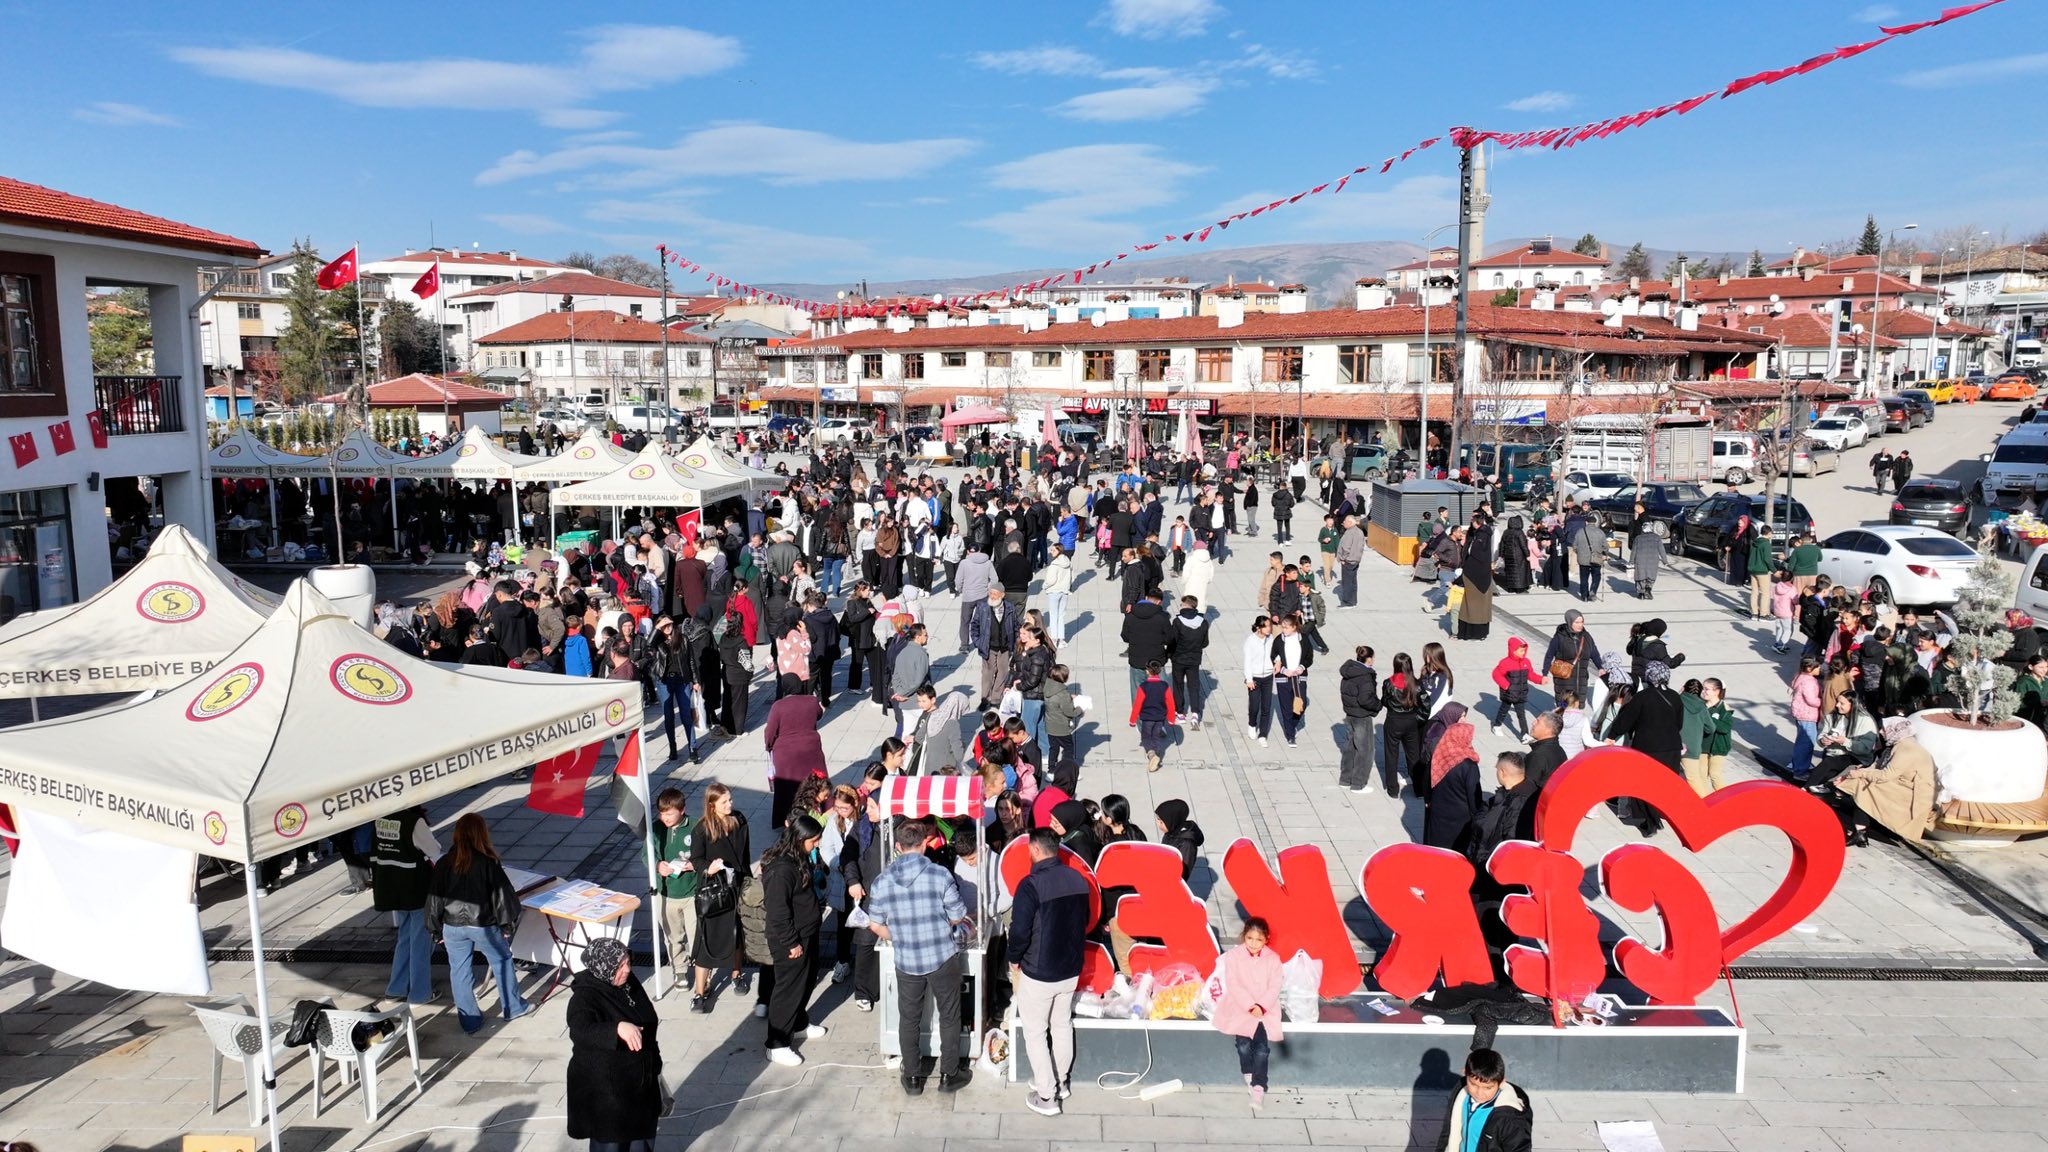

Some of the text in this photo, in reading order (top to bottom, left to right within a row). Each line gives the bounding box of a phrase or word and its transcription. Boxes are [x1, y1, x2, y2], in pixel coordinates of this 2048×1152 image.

[1085, 398, 1146, 411] AVRUPAI
[1148, 398, 1167, 411] AV
[573, 493, 680, 502] ÇERKEŞ BELEDİYE BAŞKANLIĞI
[0, 668, 82, 688] ÇERKEŞ
[88, 660, 185, 684] BELEDİYE
[322, 711, 597, 819] ÇERKEŞ BELEDİYE BAŞKANLIĞI
[0, 767, 195, 832] ERKEŞ BELEDİYE BAŞKANLIĞI
